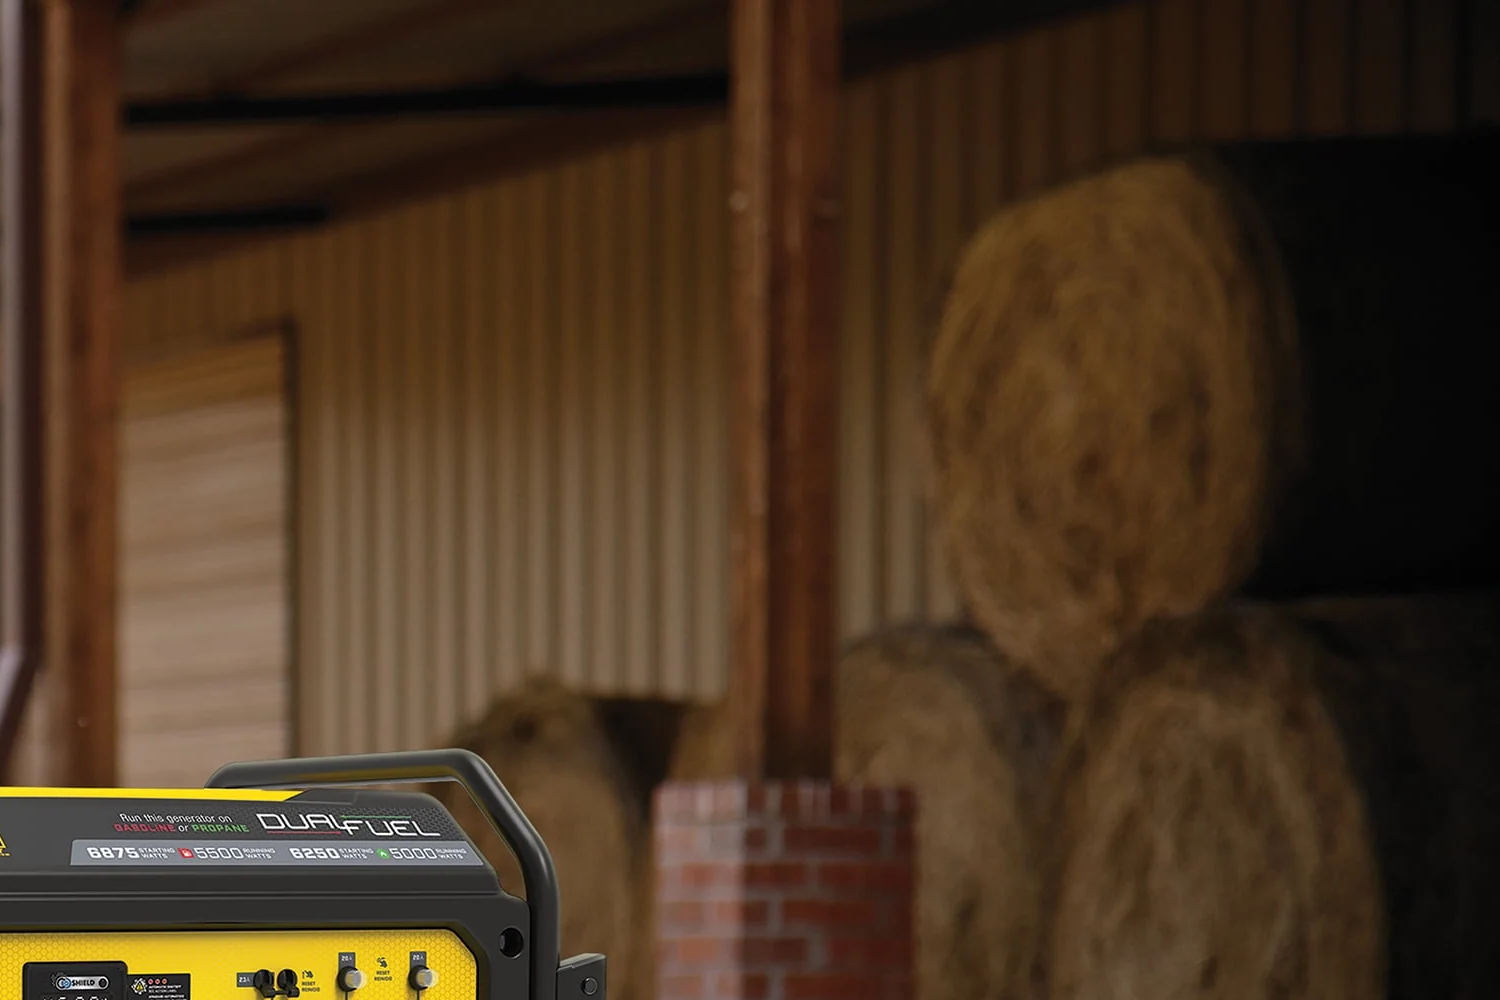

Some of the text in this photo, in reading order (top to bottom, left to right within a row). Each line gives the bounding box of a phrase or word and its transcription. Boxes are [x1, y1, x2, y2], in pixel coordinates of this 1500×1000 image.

[119, 813, 233, 825] Run this generator on
[113, 823, 250, 833] GASOLINE or PROPANE
[86, 847, 140, 859] 6875
[193, 847, 244, 859] 5500
[289, 847, 341, 860] 6250
[389, 848, 437, 860] 5000
[72, 979, 96, 987] SHIELD
